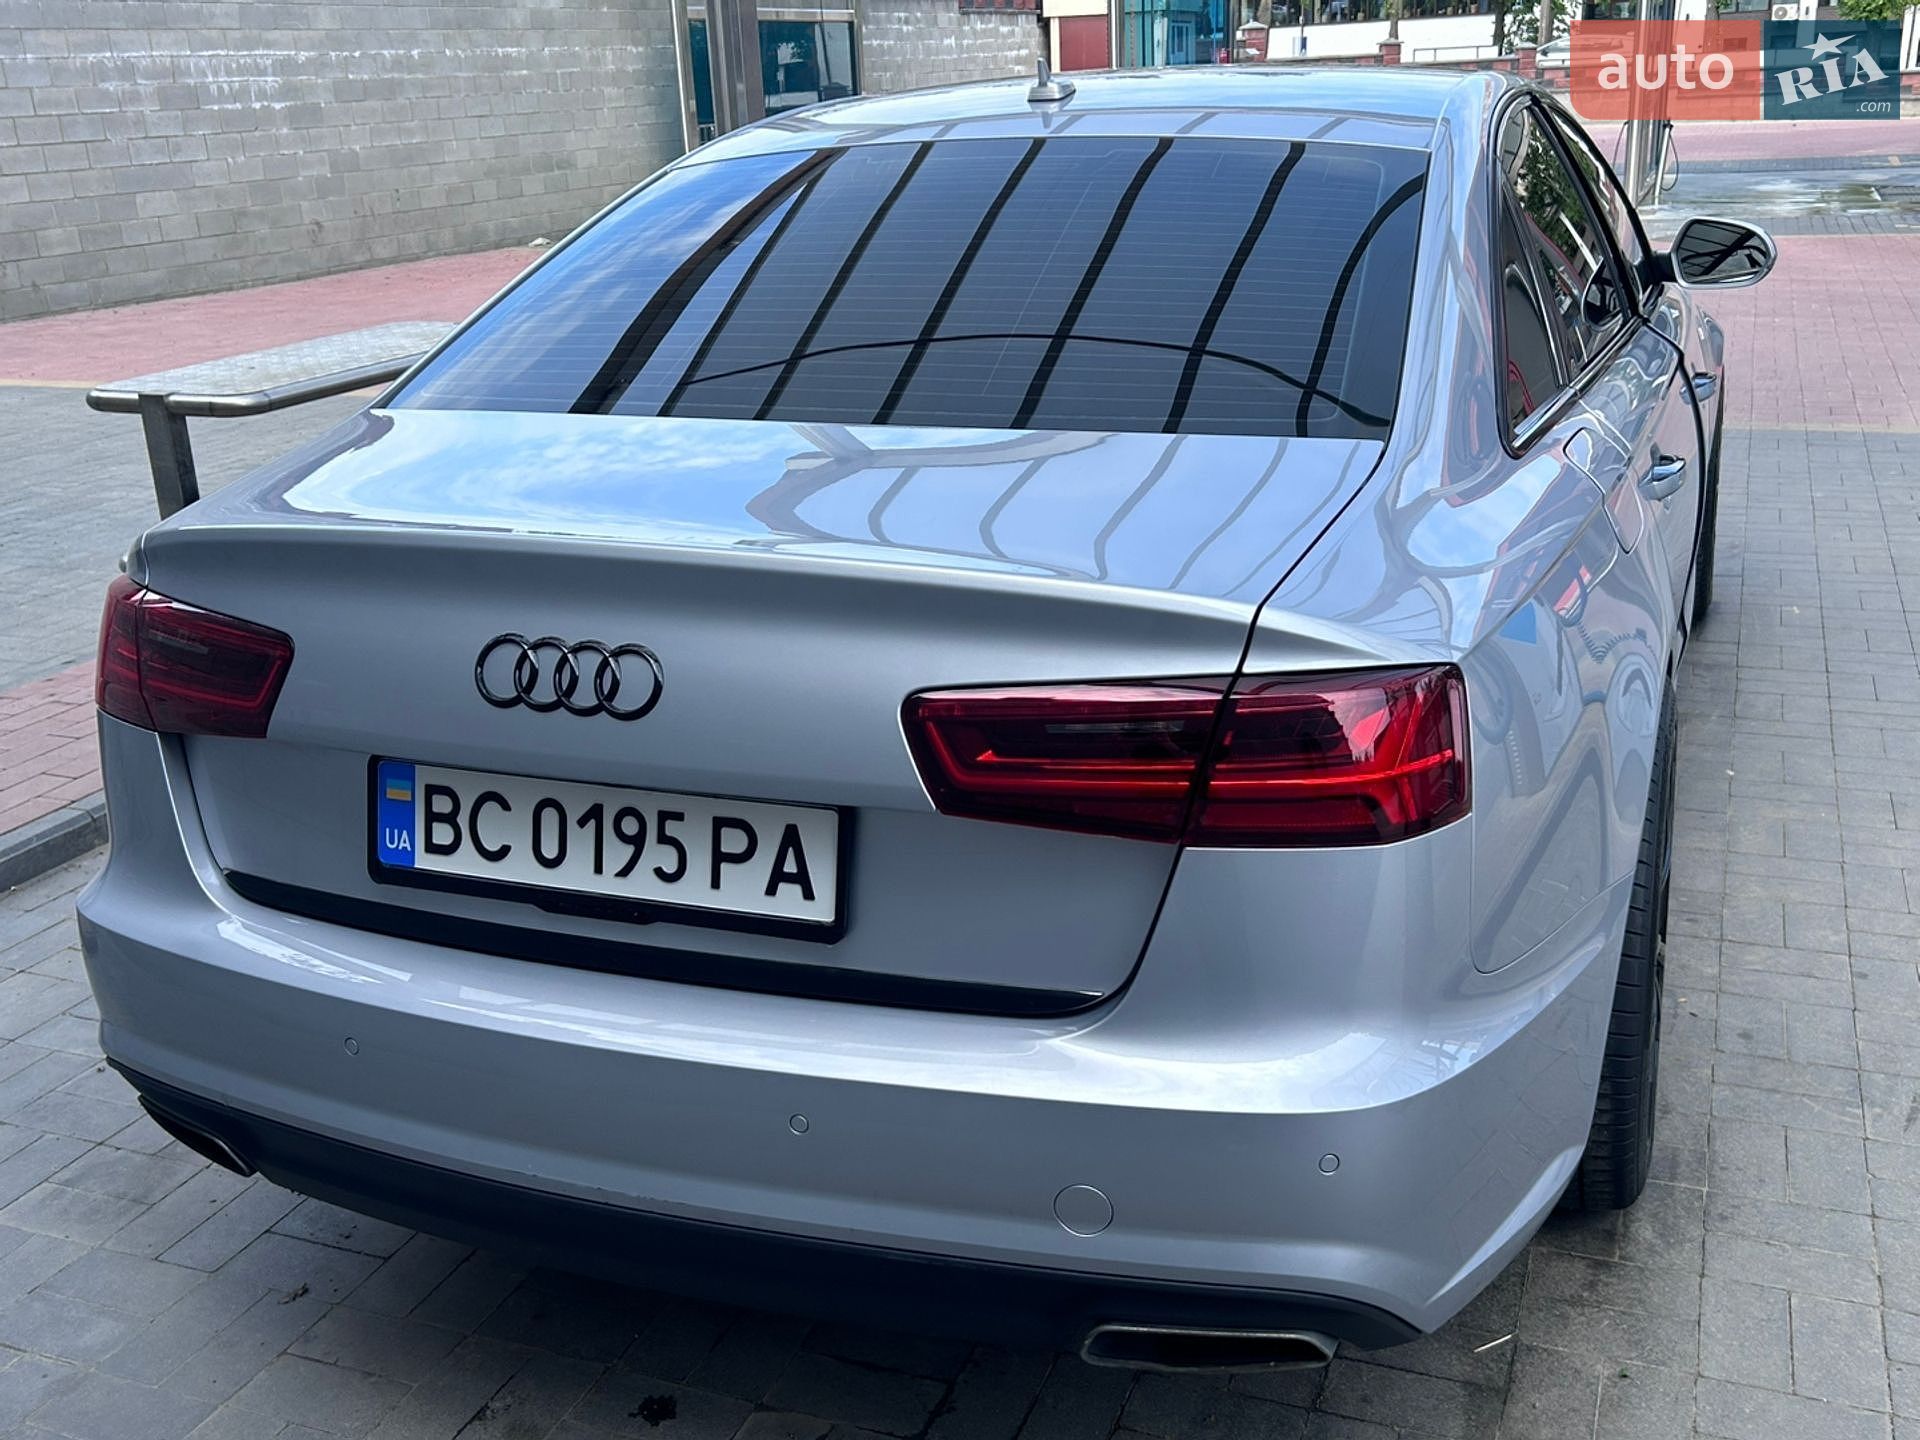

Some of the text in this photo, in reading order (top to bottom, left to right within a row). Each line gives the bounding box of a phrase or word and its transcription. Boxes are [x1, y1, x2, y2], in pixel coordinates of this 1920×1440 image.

[385, 827, 412, 852] UA
[424, 783, 816, 901] BC 0195 PA
